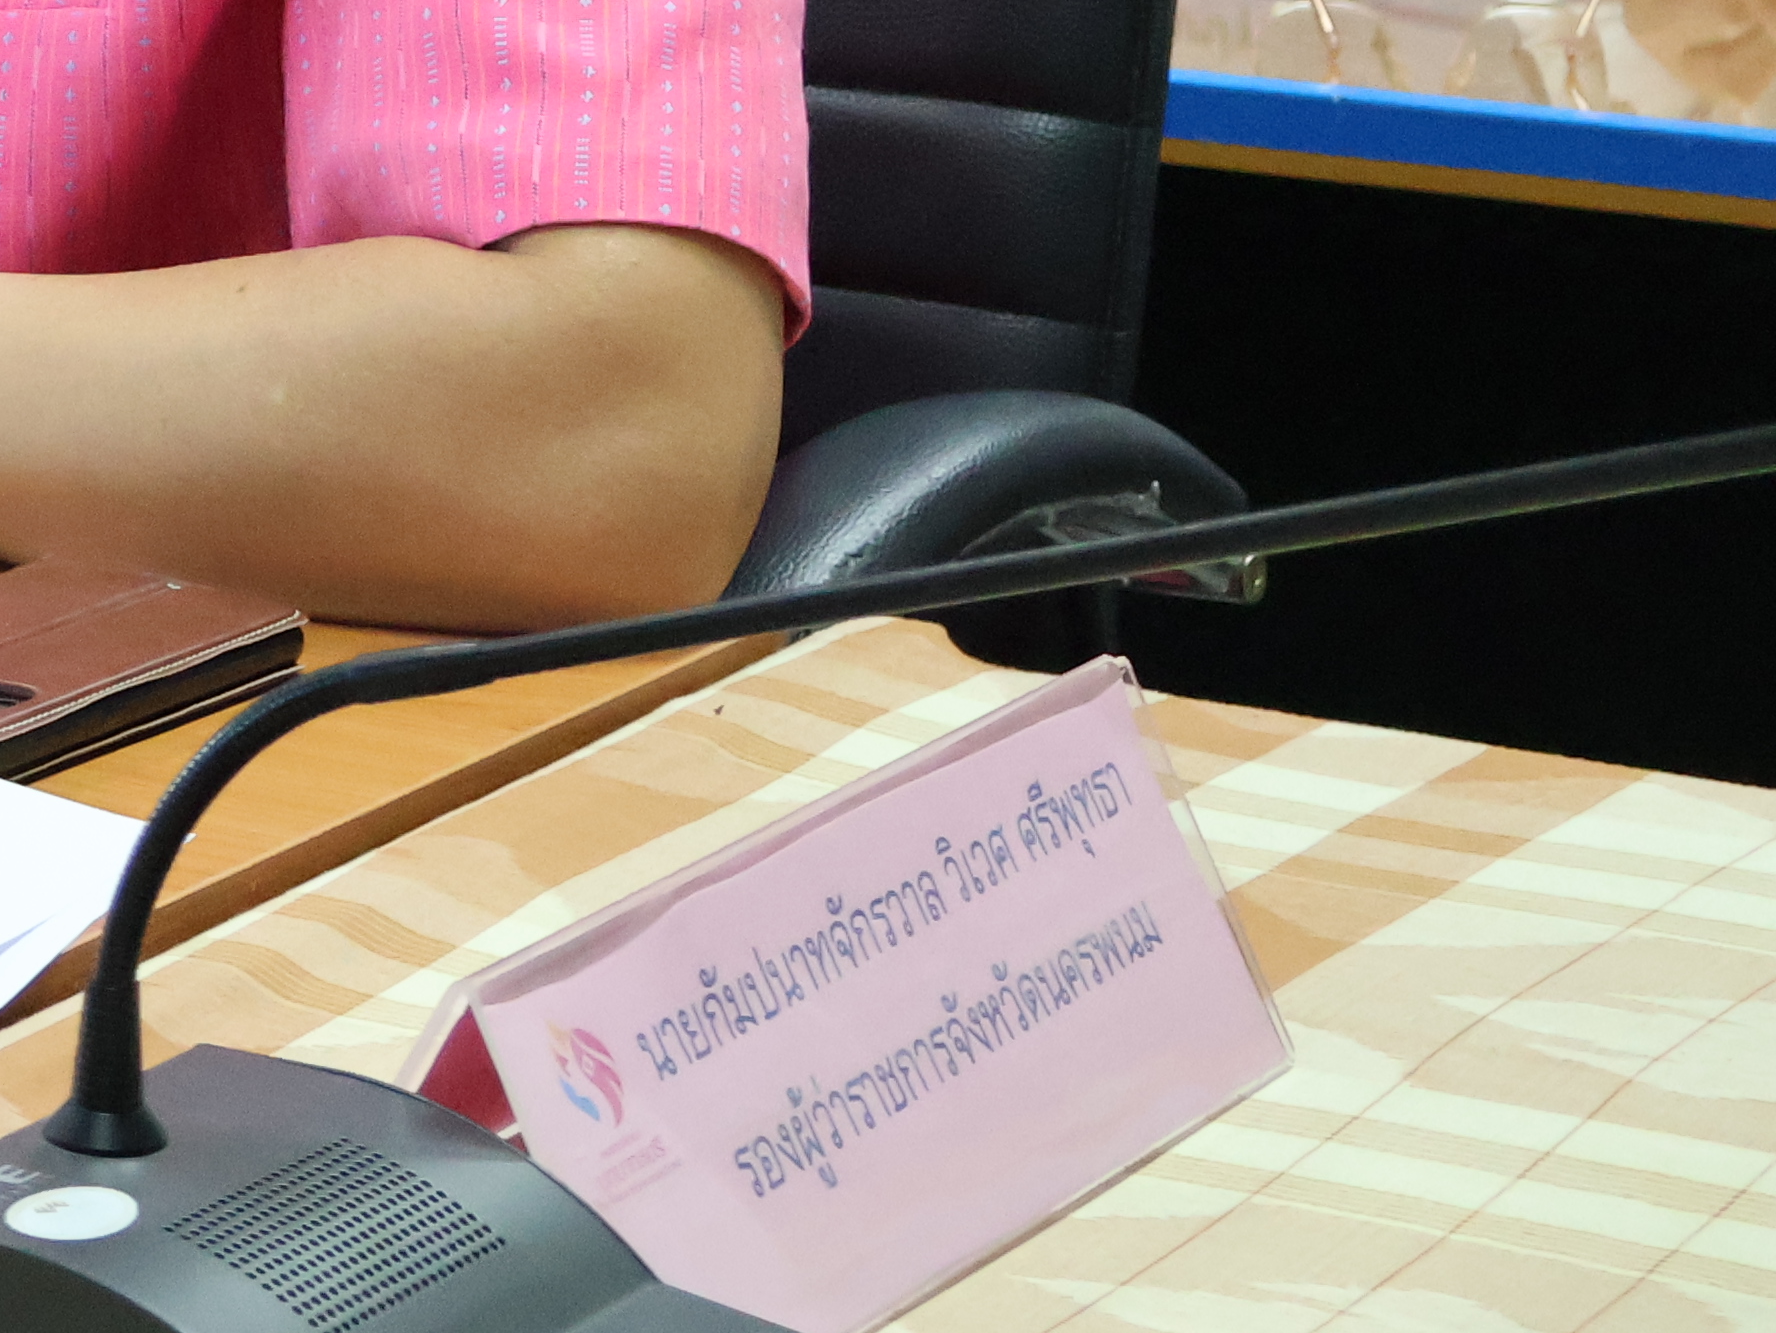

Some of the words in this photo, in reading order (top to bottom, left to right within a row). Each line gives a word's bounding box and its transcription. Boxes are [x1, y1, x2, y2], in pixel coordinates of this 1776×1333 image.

[636, 871, 947, 1081] นายกัมปนาทจักรวาล
[1017, 762, 1133, 859] ศรีพุทธา
[734, 900, 1163, 1198] รองผู้ว่าราชการจังหวัดนครพนม
